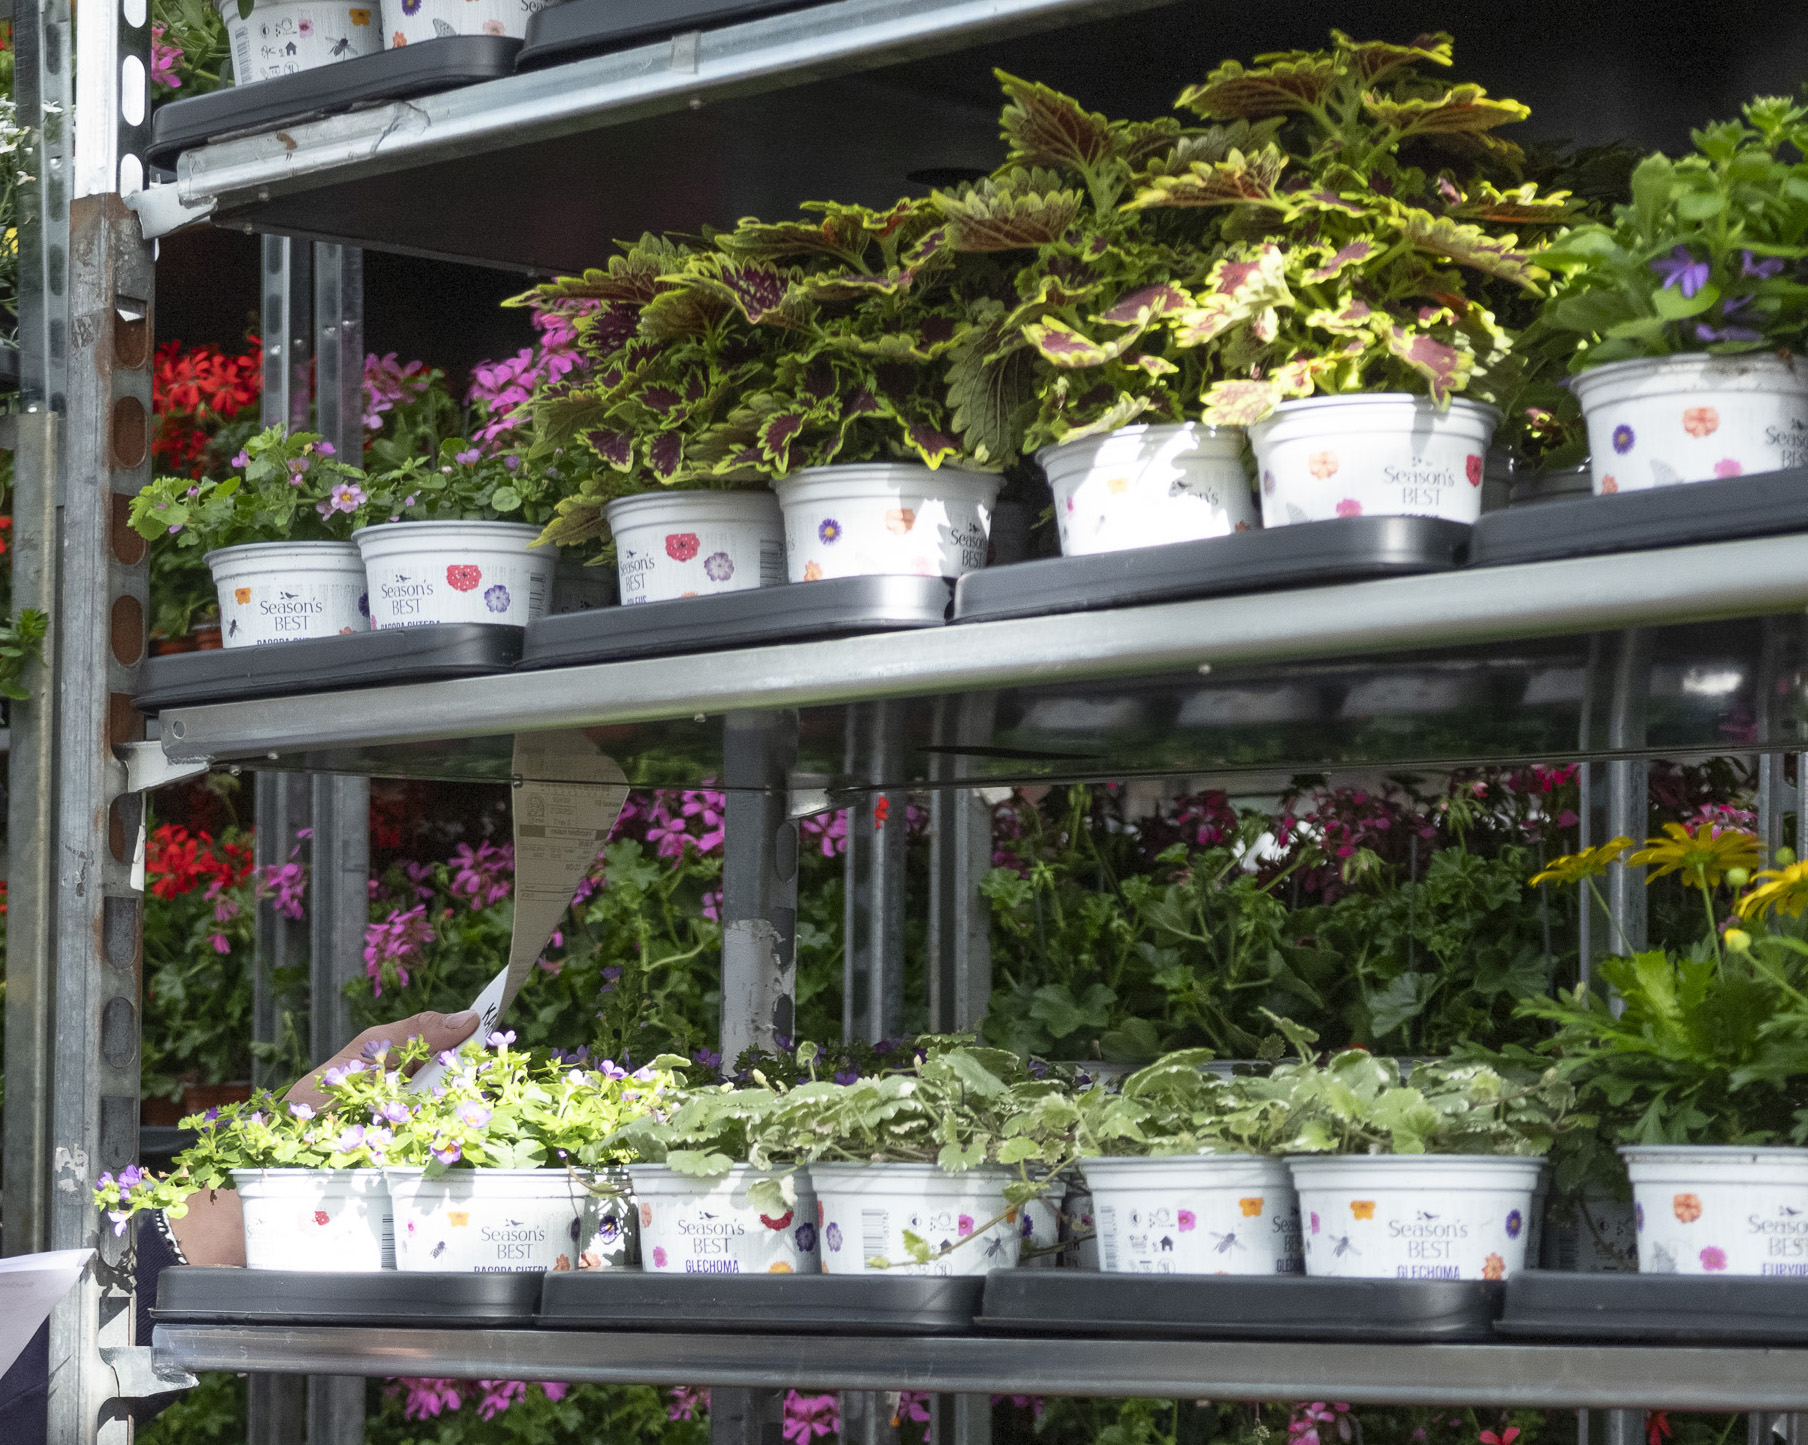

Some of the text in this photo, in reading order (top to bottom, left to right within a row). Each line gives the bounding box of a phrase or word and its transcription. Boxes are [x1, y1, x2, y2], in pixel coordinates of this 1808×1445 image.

[1384, 465, 1455, 487] Season's
[1402, 488, 1442, 506] BEST
[381, 580, 433, 600] Season's
[625, 573, 646, 591] BEST
[260, 596, 322, 615] Season's
[392, 598, 422, 615] BEST
[274, 615, 311, 631] BEST
[481, 1226, 545, 1242] Season's
[678, 1219, 745, 1238] Season's
[1389, 1219, 1468, 1238] Season's
[497, 1244, 533, 1259] BEST
[693, 1238, 732, 1253] BEST
[1408, 1241, 1450, 1259] BEST
[686, 1260, 739, 1273] GLECHOMA
[1397, 1265, 1459, 1280] GLECHOMA
